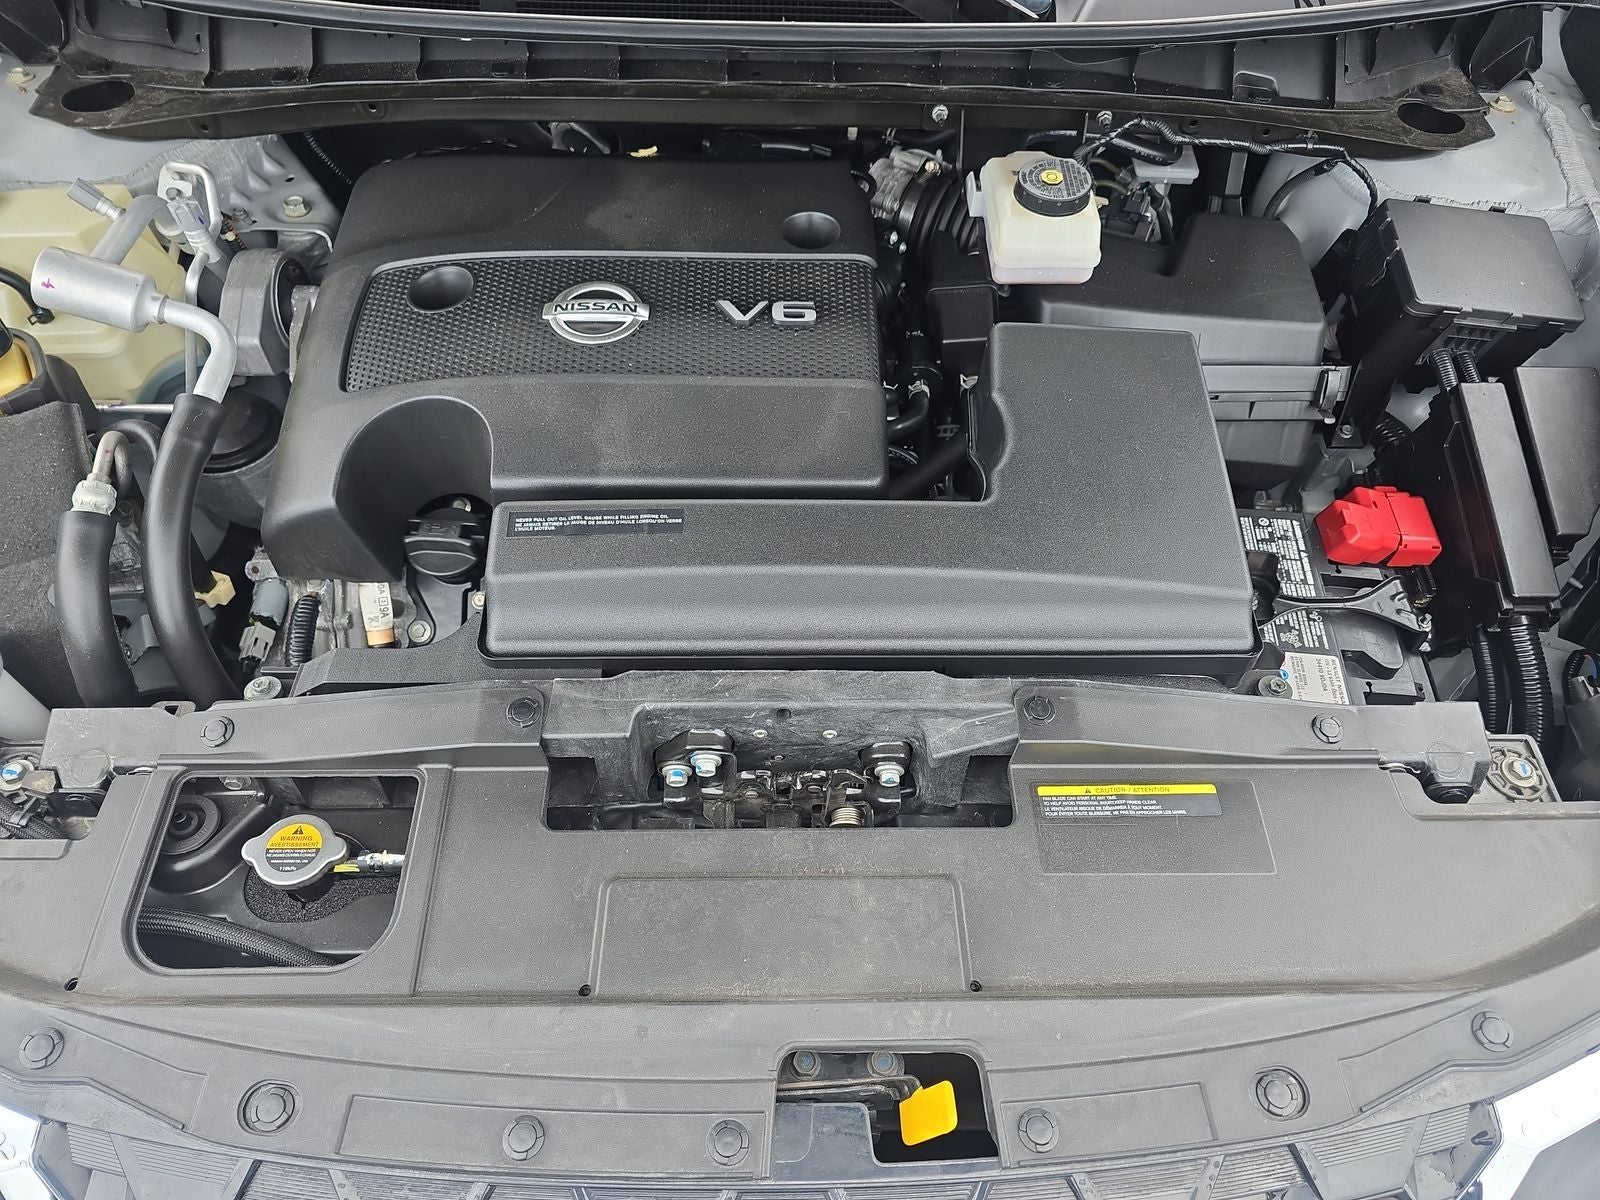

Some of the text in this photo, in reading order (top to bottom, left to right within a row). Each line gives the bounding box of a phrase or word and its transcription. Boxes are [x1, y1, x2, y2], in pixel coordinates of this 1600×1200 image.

[554, 302, 639, 313] NISSAN
[717, 299, 817, 326] V6
[379, 607, 390, 619] 9A
